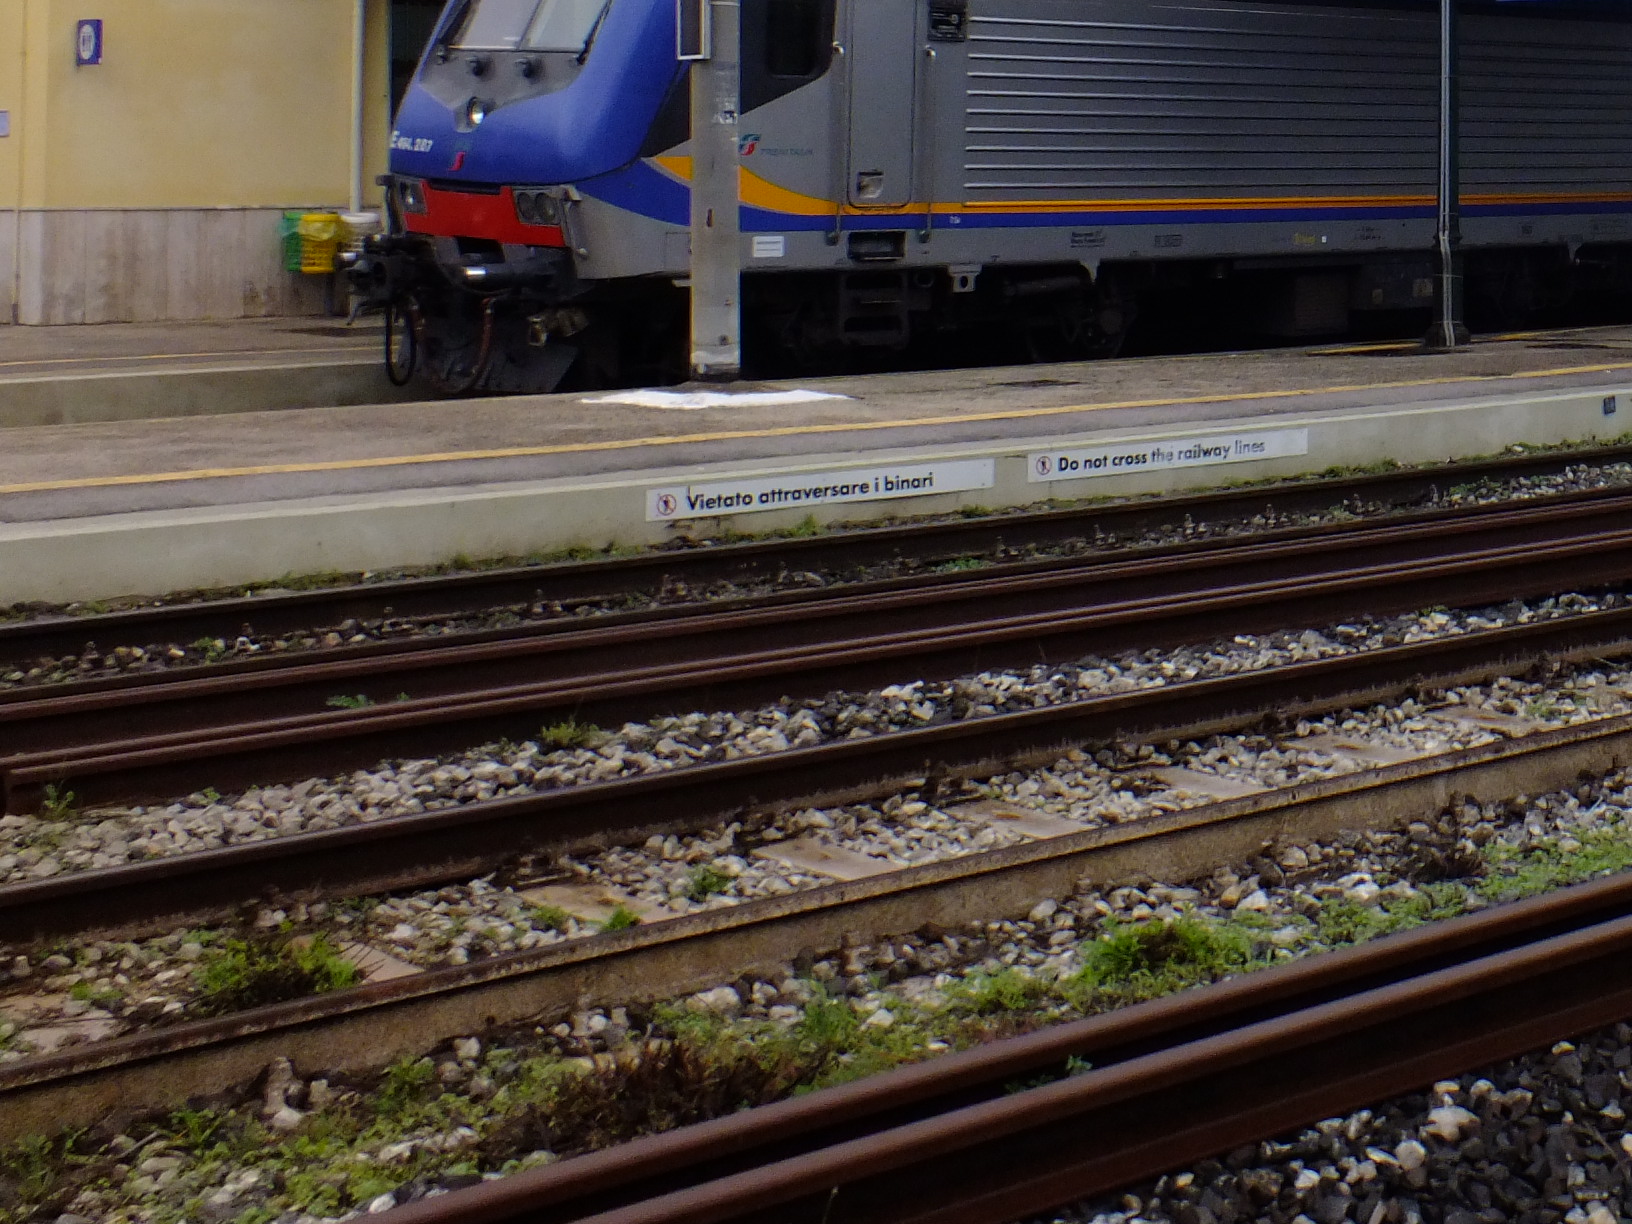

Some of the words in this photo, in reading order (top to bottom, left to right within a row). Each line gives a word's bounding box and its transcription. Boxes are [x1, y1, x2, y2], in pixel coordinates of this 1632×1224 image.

[1058, 457, 1079, 472] Do
[1084, 454, 1108, 470] not
[1112, 453, 1148, 467] cross
[1151, 447, 1174, 463] the
[1177, 443, 1231, 461] railway
[1234, 439, 1265, 455] lines
[686, 486, 753, 511] Vietato
[759, 482, 870, 506] attraversare
[874, 478, 879, 493] i
[885, 473, 934, 490] binari
